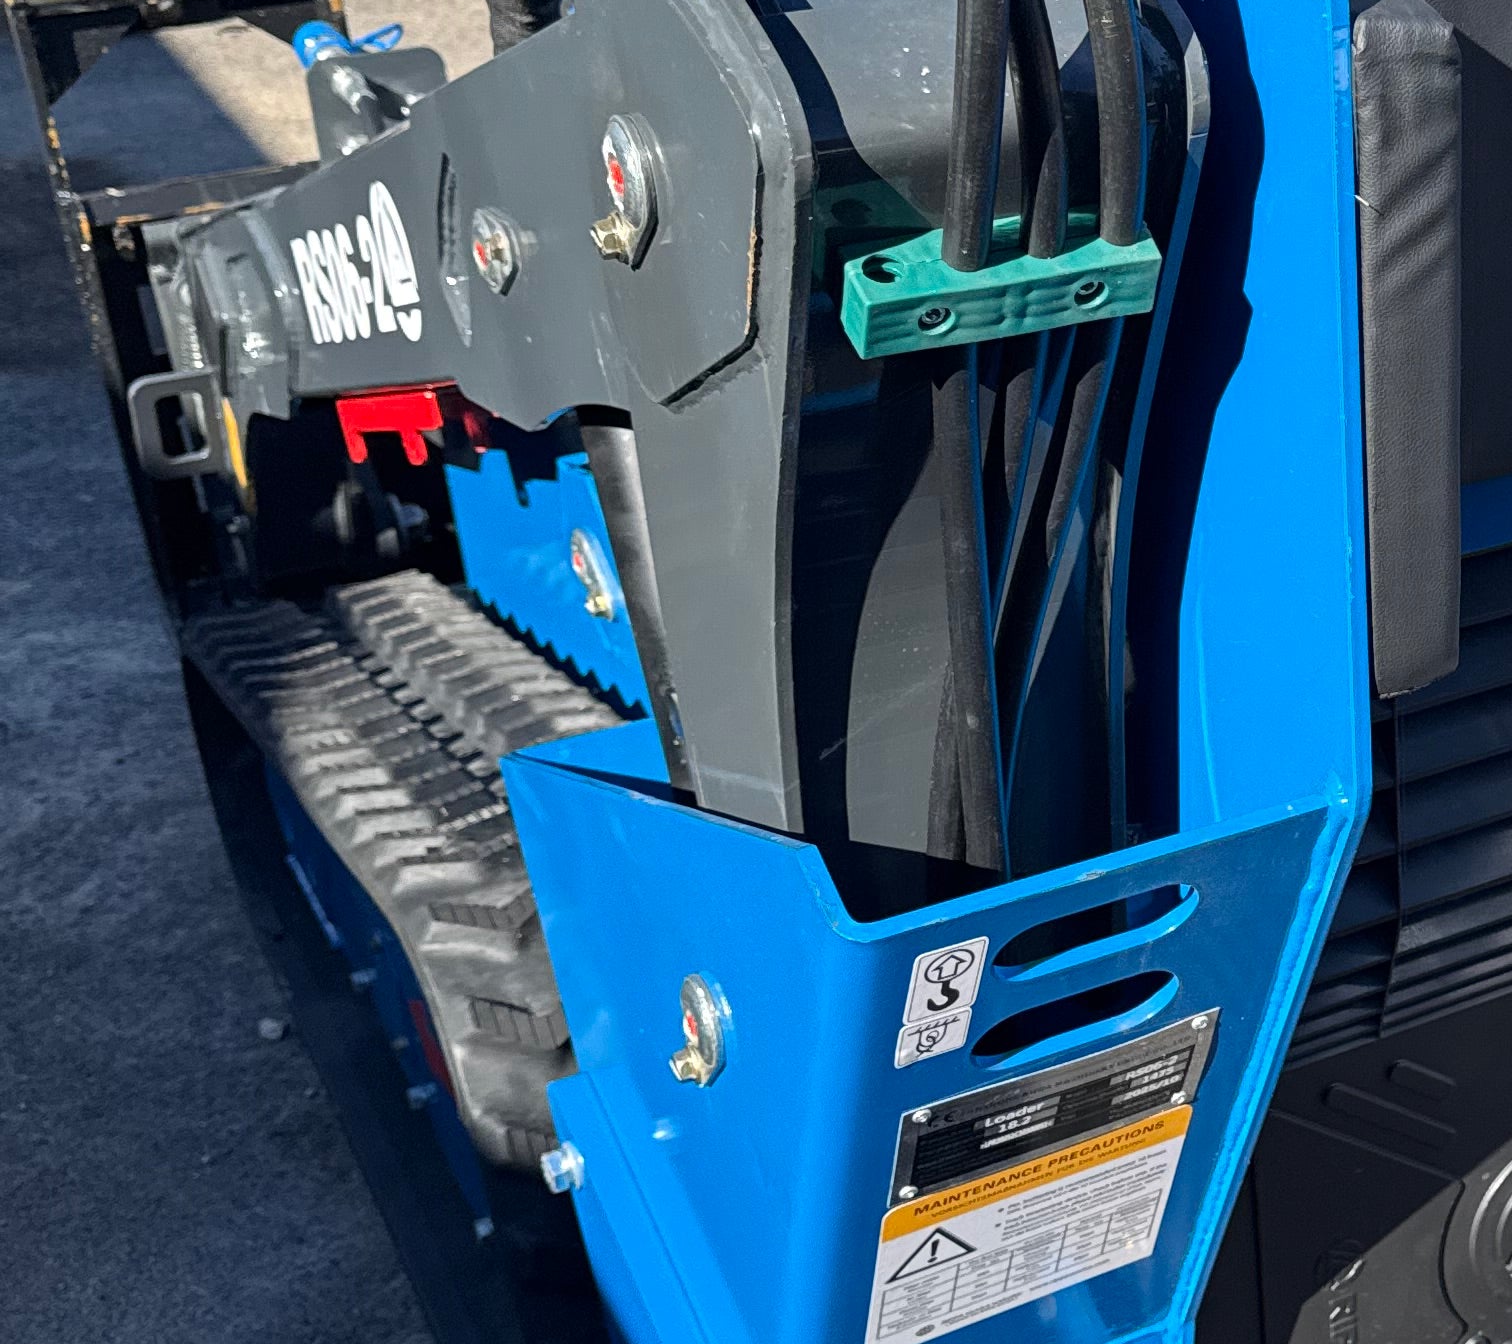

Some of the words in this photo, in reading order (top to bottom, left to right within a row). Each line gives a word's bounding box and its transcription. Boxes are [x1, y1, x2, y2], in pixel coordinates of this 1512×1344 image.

[1125, 1055, 1178, 1081] RS06-2
[985, 1102, 1044, 1128] Loader
[999, 1115, 1032, 1134] 18.2
[914, 1164, 1042, 1217] MAINTENANCE
[1048, 1120, 1165, 1169] PRECAUTIONS
